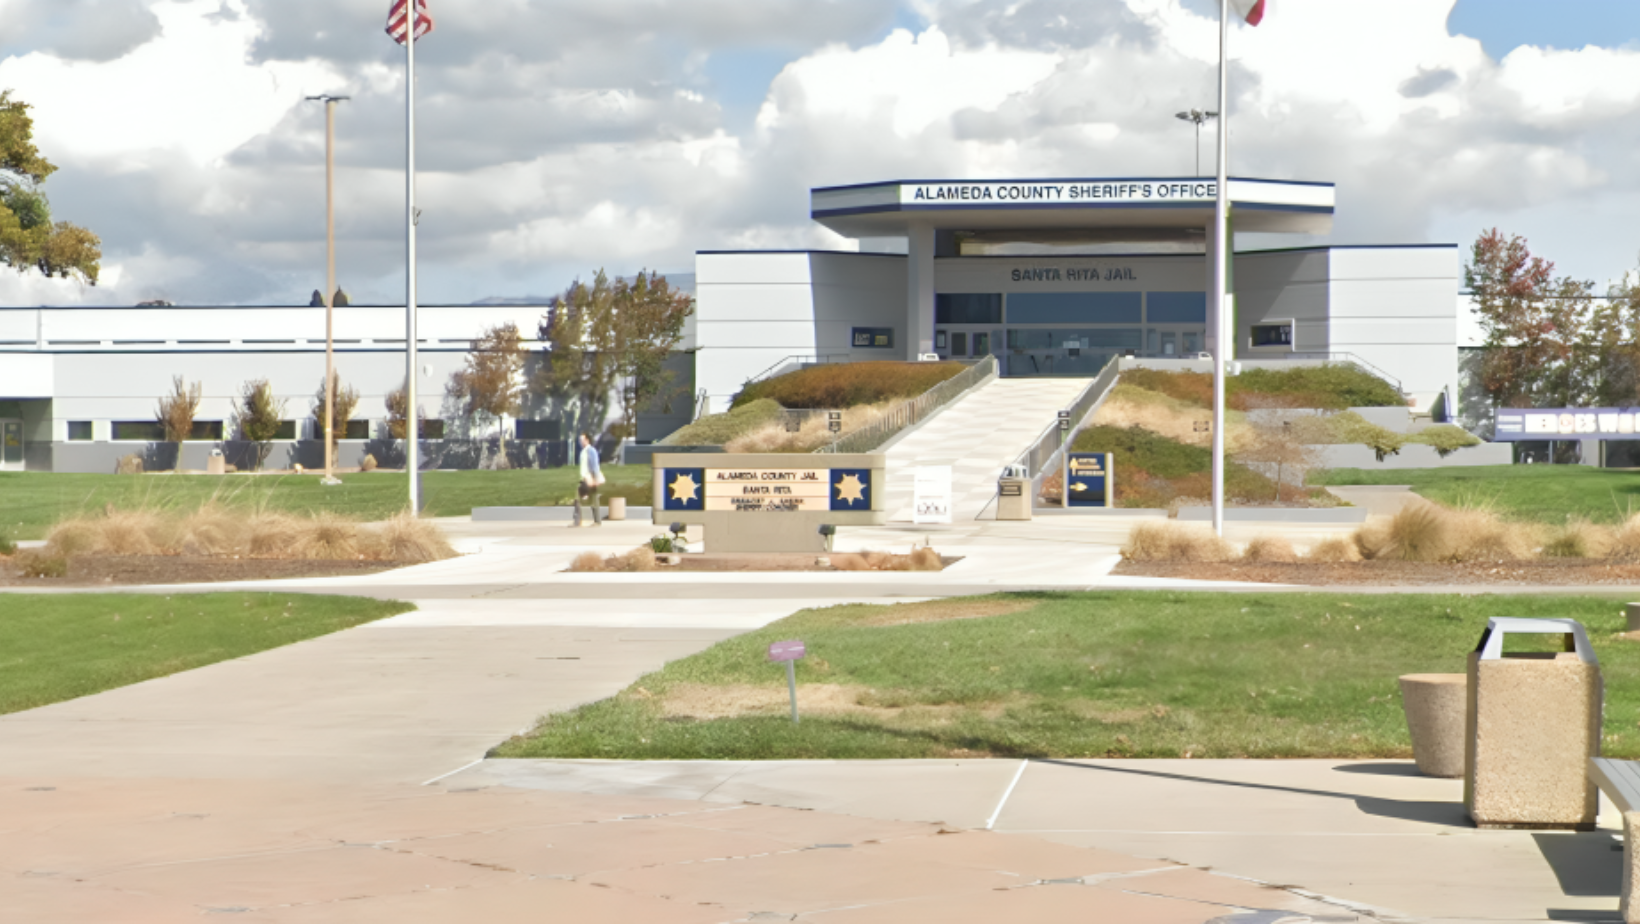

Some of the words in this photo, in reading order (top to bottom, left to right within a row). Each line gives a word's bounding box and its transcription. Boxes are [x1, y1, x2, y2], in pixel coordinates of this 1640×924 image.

[914, 186, 993, 200] ALAMEDA
[997, 185, 1064, 200] COUNTY
[1068, 184, 1152, 199] SHERIFF'S
[1157, 184, 1217, 197] OFFICE
[1011, 267, 1062, 281] SANTA
[1066, 267, 1100, 281] RITA
[1104, 267, 1137, 281] JAIL
[716, 472, 758, 480] ALAMEDA
[761, 472, 797, 480] COUNTY
[800, 472, 819, 480] JAIL
